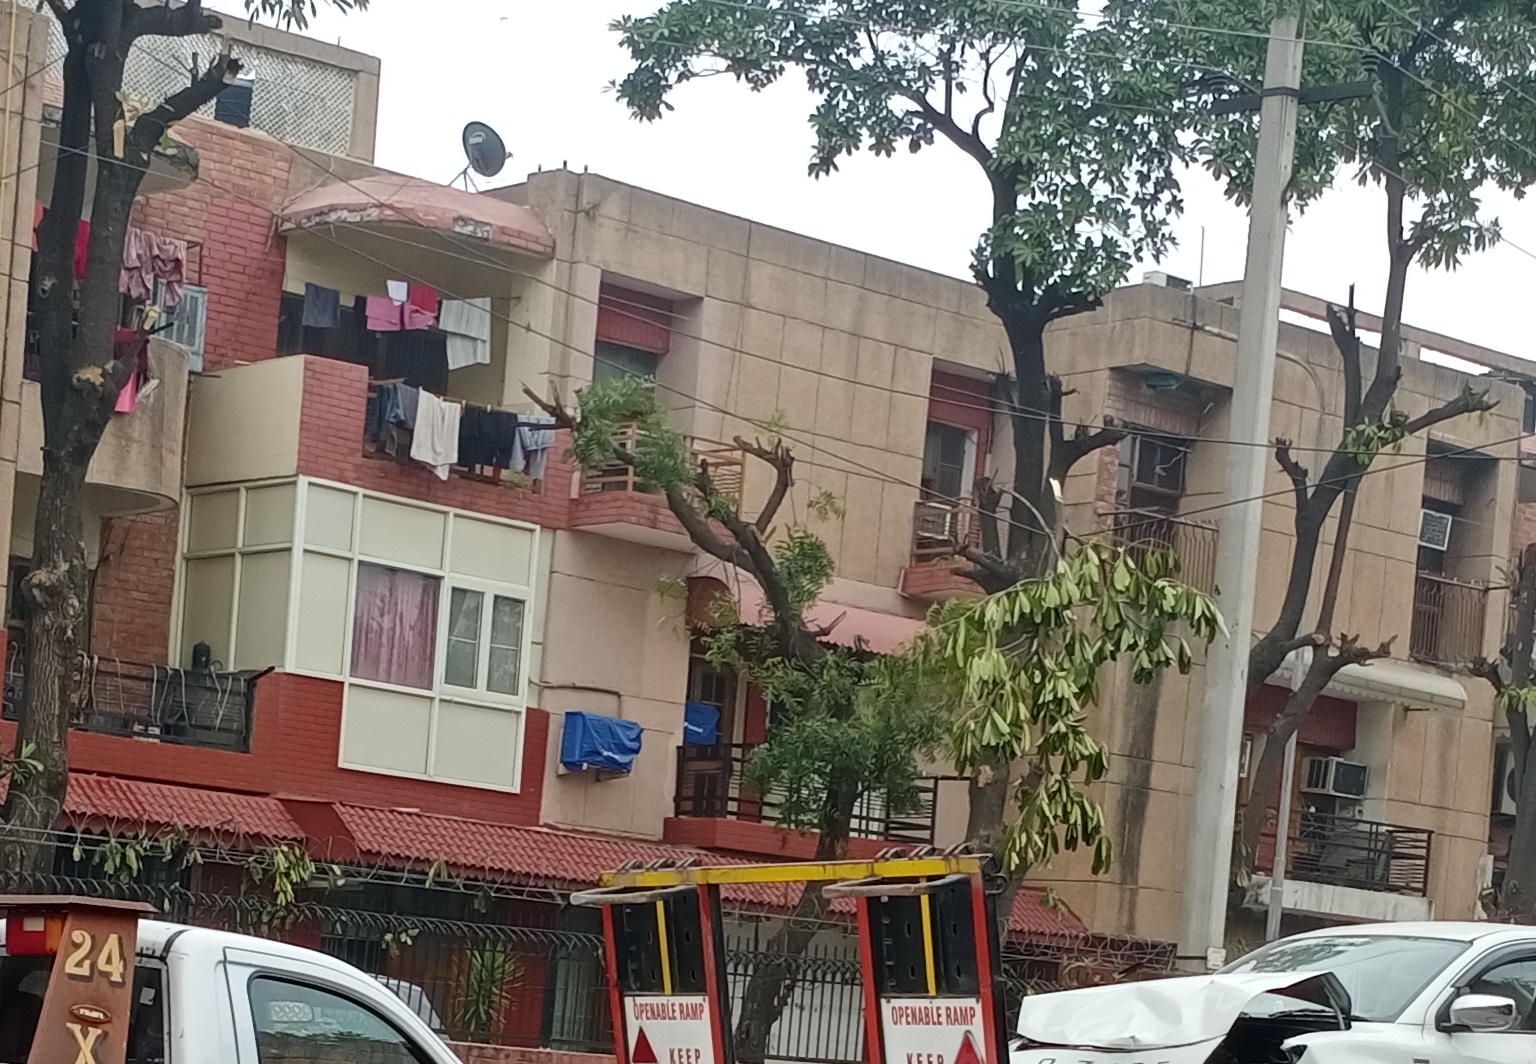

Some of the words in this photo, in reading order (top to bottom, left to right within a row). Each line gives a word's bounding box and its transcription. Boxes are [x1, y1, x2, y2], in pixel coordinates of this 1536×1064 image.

[64, 929, 125, 984] 24
[633, 1002, 677, 1021] OPENABLE
[679, 1002, 705, 1021] RAMP
[891, 1005, 943, 1026] OPENABLE
[945, 1006, 976, 1026] RAMP
